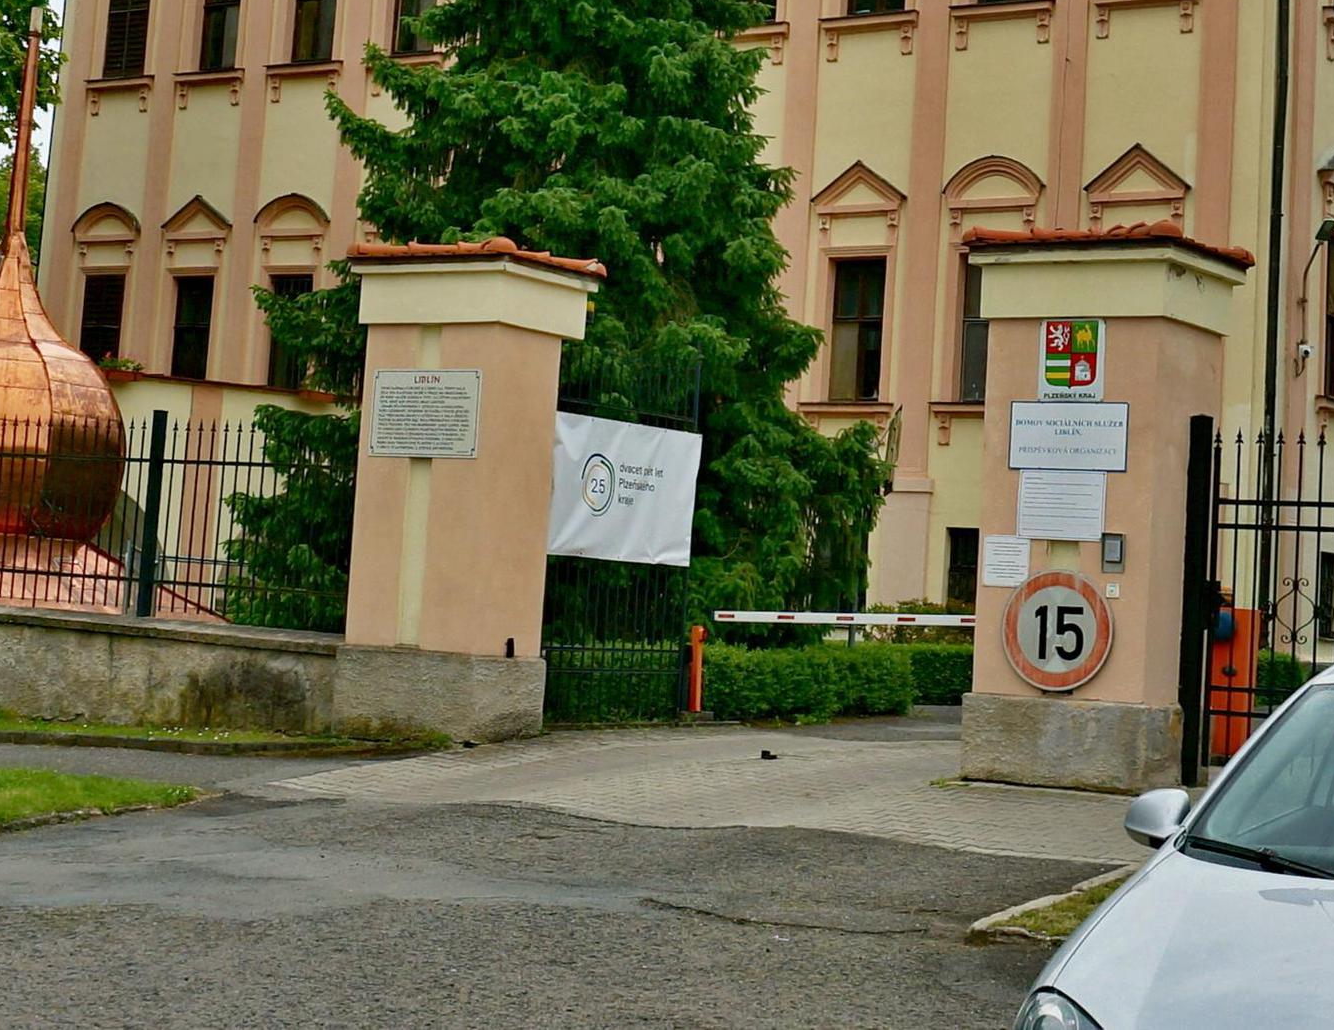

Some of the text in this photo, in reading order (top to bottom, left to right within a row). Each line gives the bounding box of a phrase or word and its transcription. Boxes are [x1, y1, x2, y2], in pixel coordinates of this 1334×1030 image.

[1015, 419, 1043, 427] DOMOV
[619, 464, 642, 475] dvacet
[590, 478, 607, 494] 25
[618, 477, 656, 492] Plzeňského
[618, 494, 634, 506] kraje
[1034, 604, 1085, 661] 15
